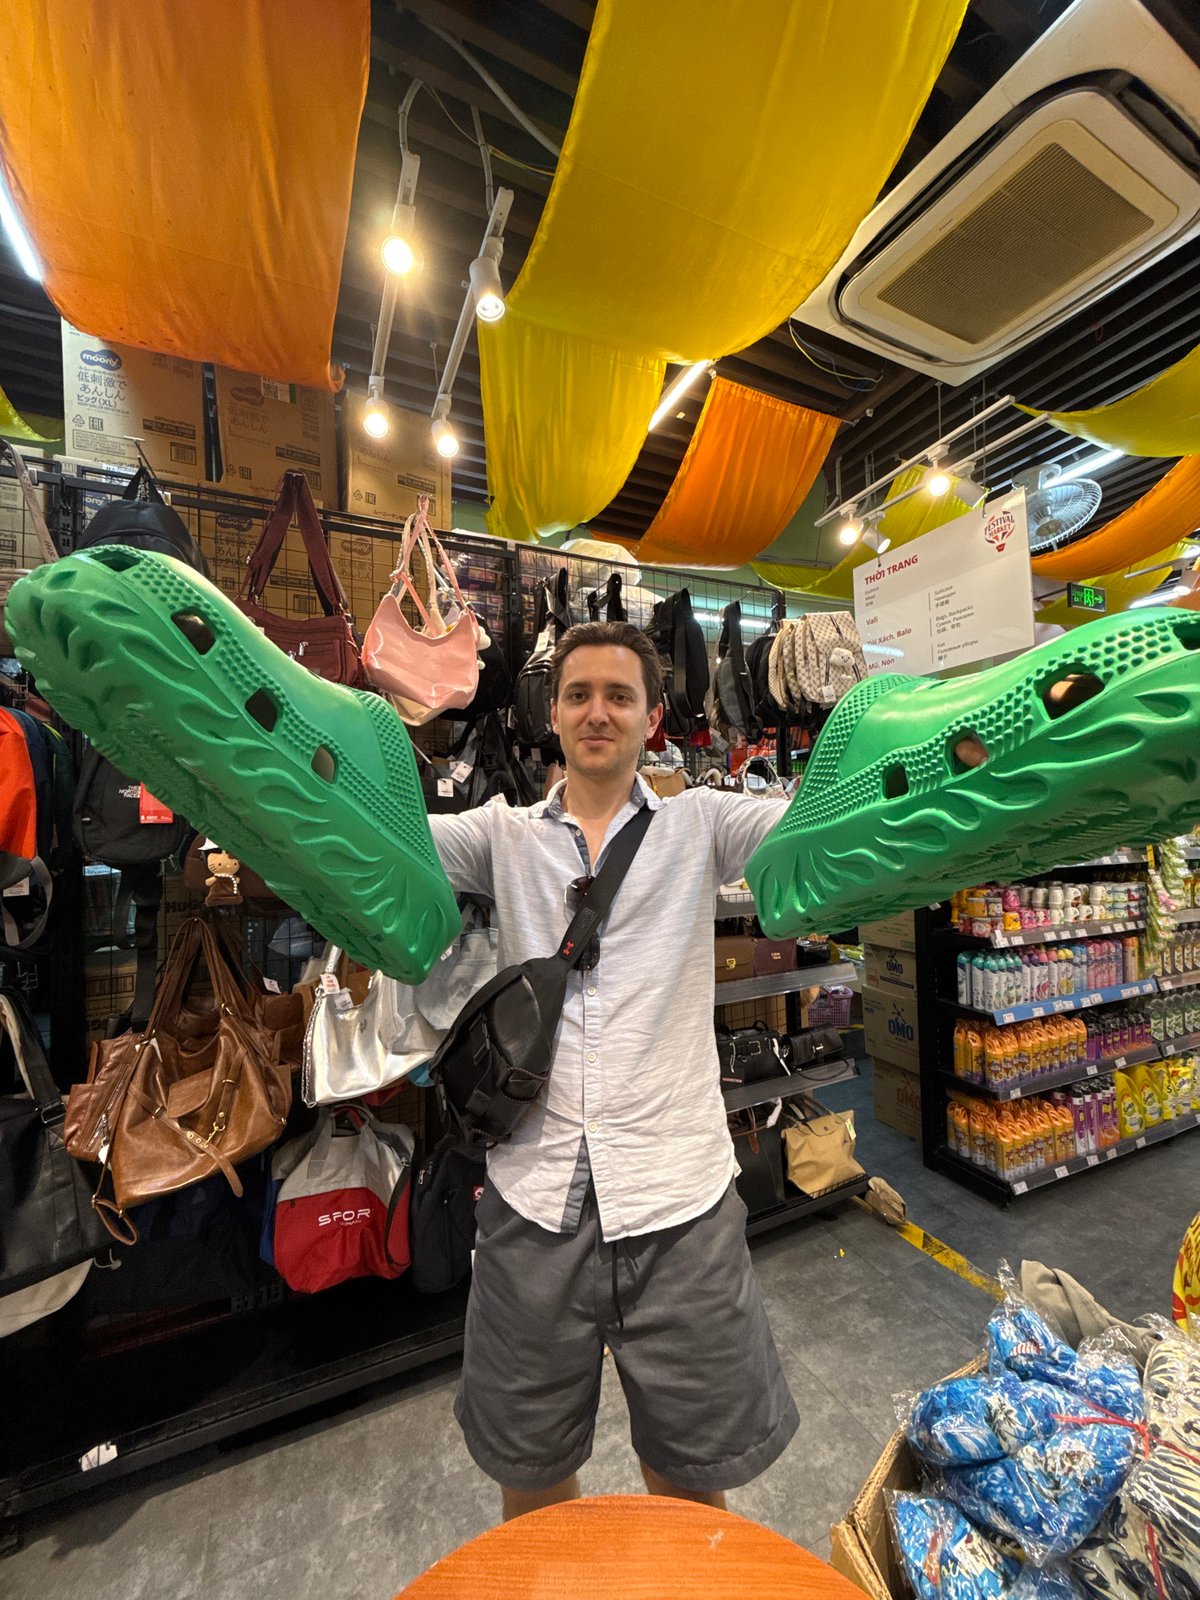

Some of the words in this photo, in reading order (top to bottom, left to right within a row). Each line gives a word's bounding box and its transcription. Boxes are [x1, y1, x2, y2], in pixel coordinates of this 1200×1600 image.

[82, 353, 118, 367] moony
[77, 371, 127, 391] 低刺激で
[79, 382, 126, 401] あんしん
[985, 514, 1015, 534] FESTIVAL
[988, 523, 1012, 537] MARKET
[864, 569, 886, 585] THỜI
[887, 555, 918, 574] TRANG
[866, 616, 879, 626] Vali
[896, 627, 912, 639] Balo
[881, 656, 896, 669] Nón
[886, 961, 904, 975] OMO
[887, 1018, 915, 1041] OMO
